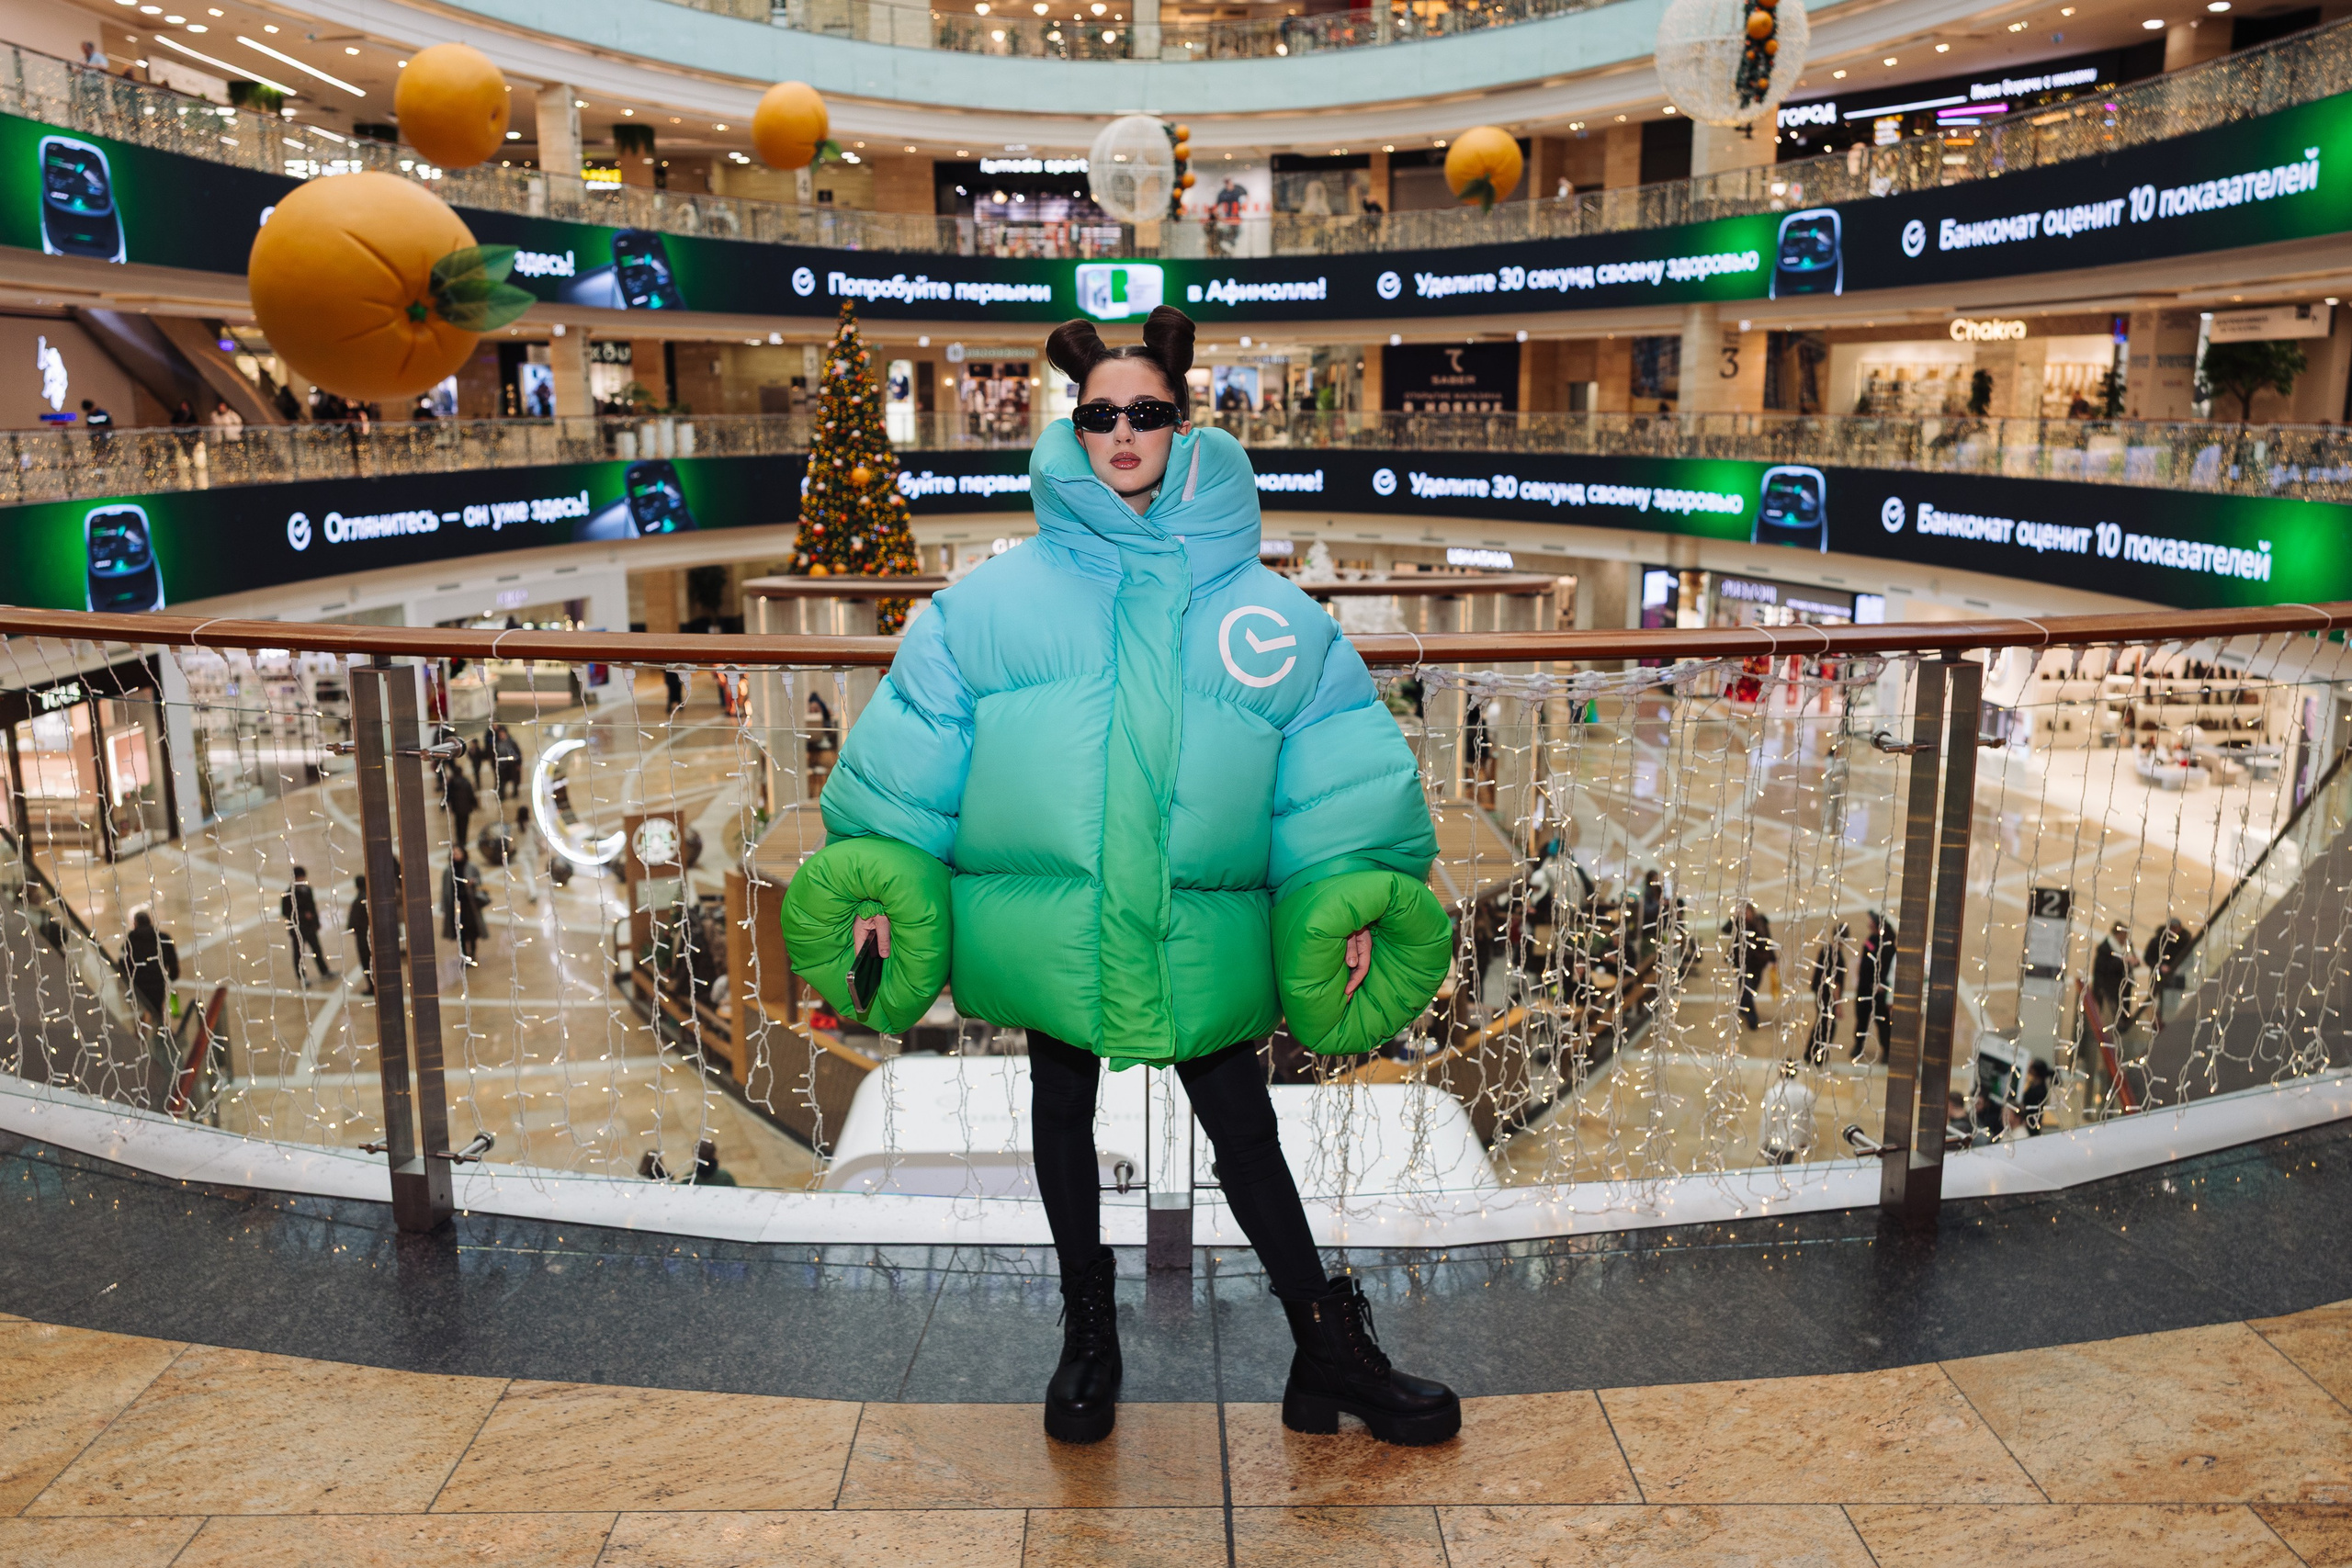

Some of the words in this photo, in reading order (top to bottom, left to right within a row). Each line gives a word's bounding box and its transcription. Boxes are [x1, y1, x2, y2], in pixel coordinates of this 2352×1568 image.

[1777, 102, 1837, 129] ГОРОД
[1939, 213, 2041, 250] Банкомат
[2043, 198, 2125, 238] оценит
[2130, 185, 2155, 222] 10
[2159, 148, 2319, 218] показателей
[514, 250, 575, 277] здесь!
[1415, 273, 1497, 299] Уделите
[1498, 266, 1525, 291] 30
[1527, 266, 1595, 293] секунд
[1597, 260, 1665, 286] своему
[1667, 251, 1758, 281] здоровью
[829, 272, 951, 303] Попробуйте
[955, 283, 1050, 304] первыми
[1188, 286, 1202, 301] в
[1205, 276, 1326, 305] Афимолле!
[1950, 319, 2027, 342] Chakra
[1720, 347, 1738, 378] 3
[899, 471, 956, 500] буйте
[1409, 472, 1489, 499] Уделите
[1492, 475, 1518, 499] 30
[1520, 482, 1586, 506] секунд
[1588, 485, 1651, 512] своему
[1653, 489, 1743, 515] здоровью
[324, 511, 438, 543] Оглянитесь
[464, 505, 489, 527] он
[491, 502, 528, 530] уже
[530, 491, 589, 523] здесь!
[1917, 503, 2015, 544] Банкомат
[2017, 522, 2092, 554] оценит
[2096, 523, 2120, 558] 10
[2124, 535, 2271, 581] показателей
[2041, 890, 2061, 916] 2
